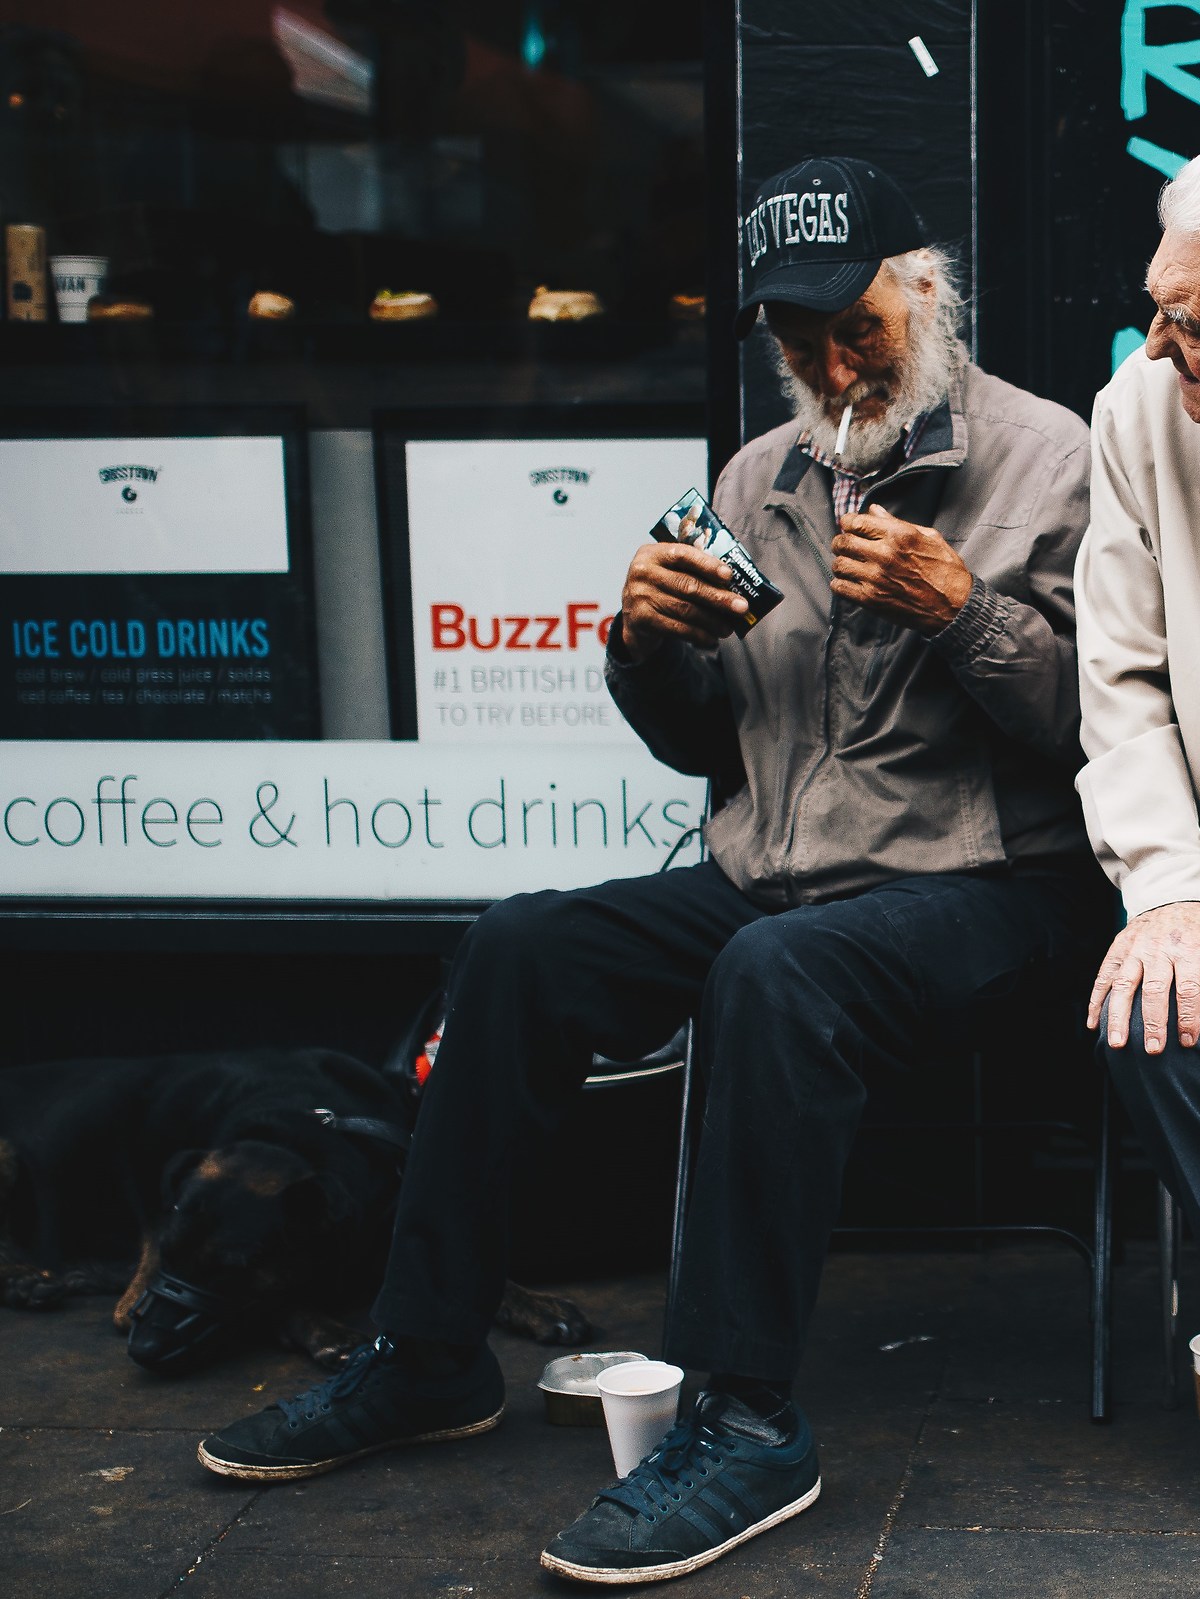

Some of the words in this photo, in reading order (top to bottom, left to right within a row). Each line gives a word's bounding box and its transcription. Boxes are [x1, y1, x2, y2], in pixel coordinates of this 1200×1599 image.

[745, 201, 768, 267] LAS
[767, 193, 849, 249] VEGAS
[728, 547, 763, 587] Smoking
[739, 577, 760, 599] your
[13, 619, 60, 658] ICE
[69, 619, 146, 658] COLD
[156, 618, 270, 658] DRINKS
[136, 670, 174, 687] press
[177, 668, 212, 687] juice
[433, 667, 461, 694] #1
[471, 666, 576, 694] BRITISH
[136, 688, 205, 704] chocolate
[217, 687, 272, 703] matcha
[437, 704, 467, 727] TO
[476, 704, 513, 727] TRY
[521, 704, 611, 727] BEFORE
[3, 775, 224, 848] coffee
[249, 781, 297, 847] &
[324, 776, 444, 848] hot
[468, 776, 693, 849] drinks
